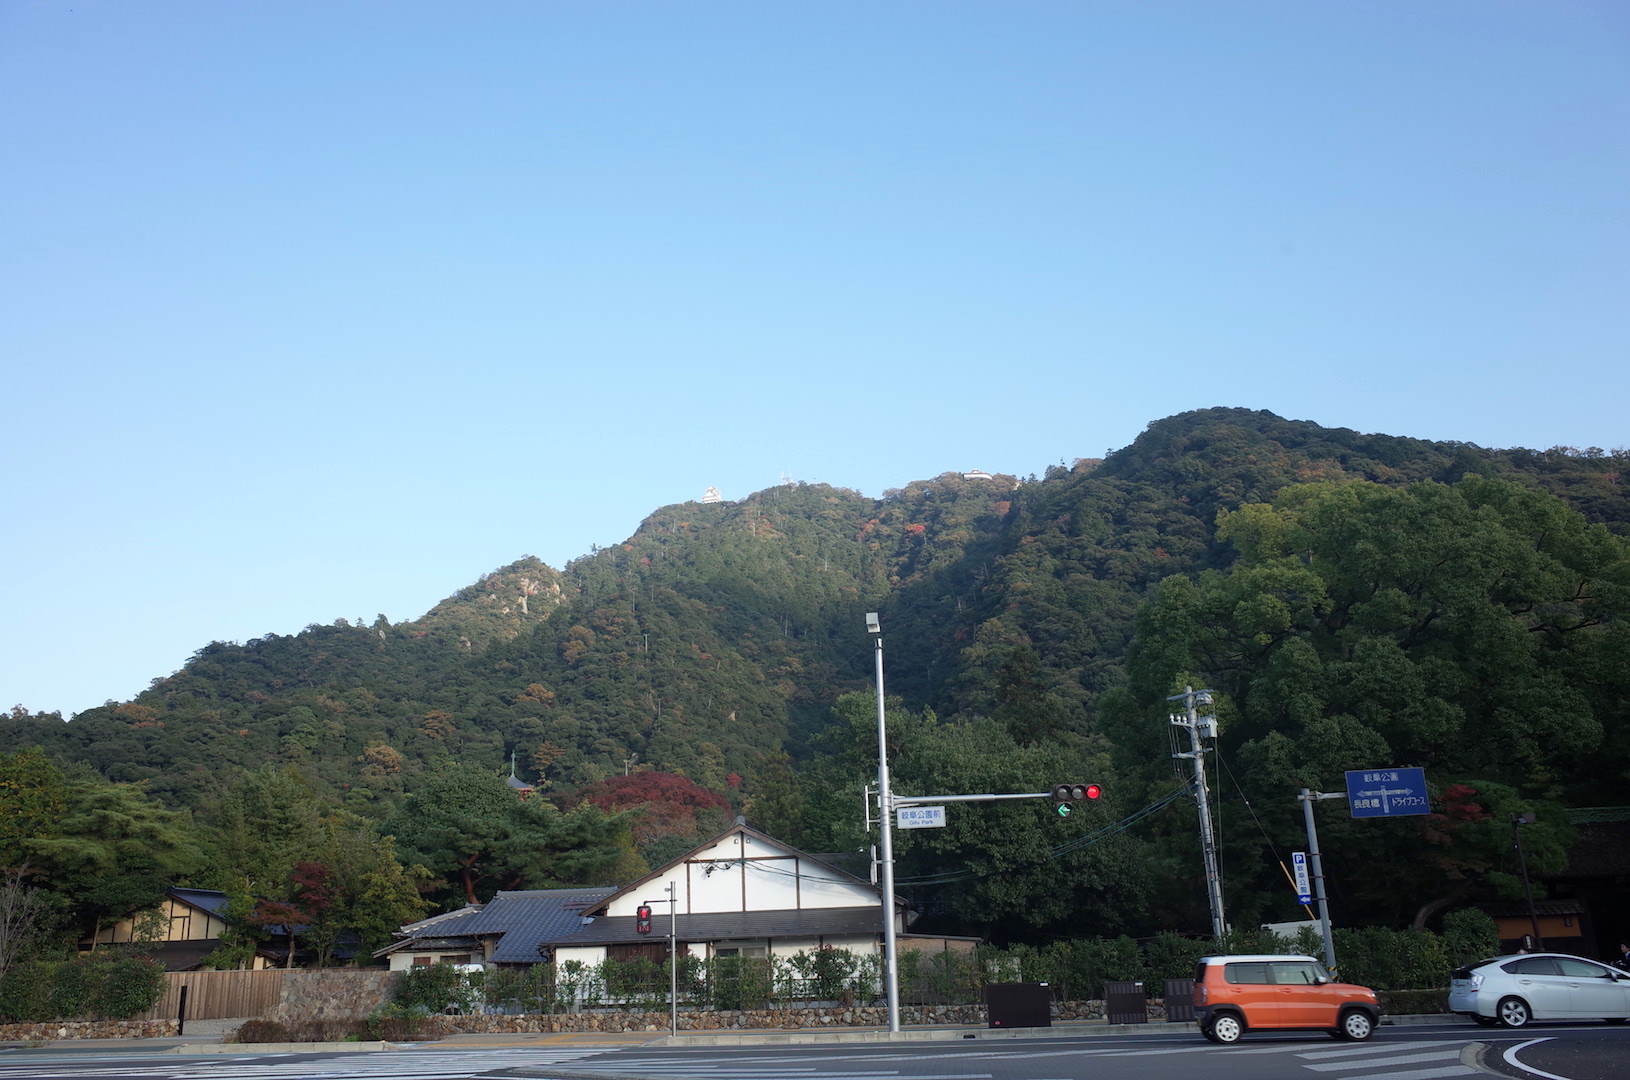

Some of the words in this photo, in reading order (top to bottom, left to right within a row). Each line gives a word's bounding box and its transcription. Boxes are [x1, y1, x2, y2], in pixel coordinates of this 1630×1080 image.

[1364, 772, 1399, 783] 岐阜公園
[1354, 798, 1381, 809] 長良橋
[901, 809, 941, 820] 岐阜公園前
[1297, 865, 1308, 894] 岐阜公園
